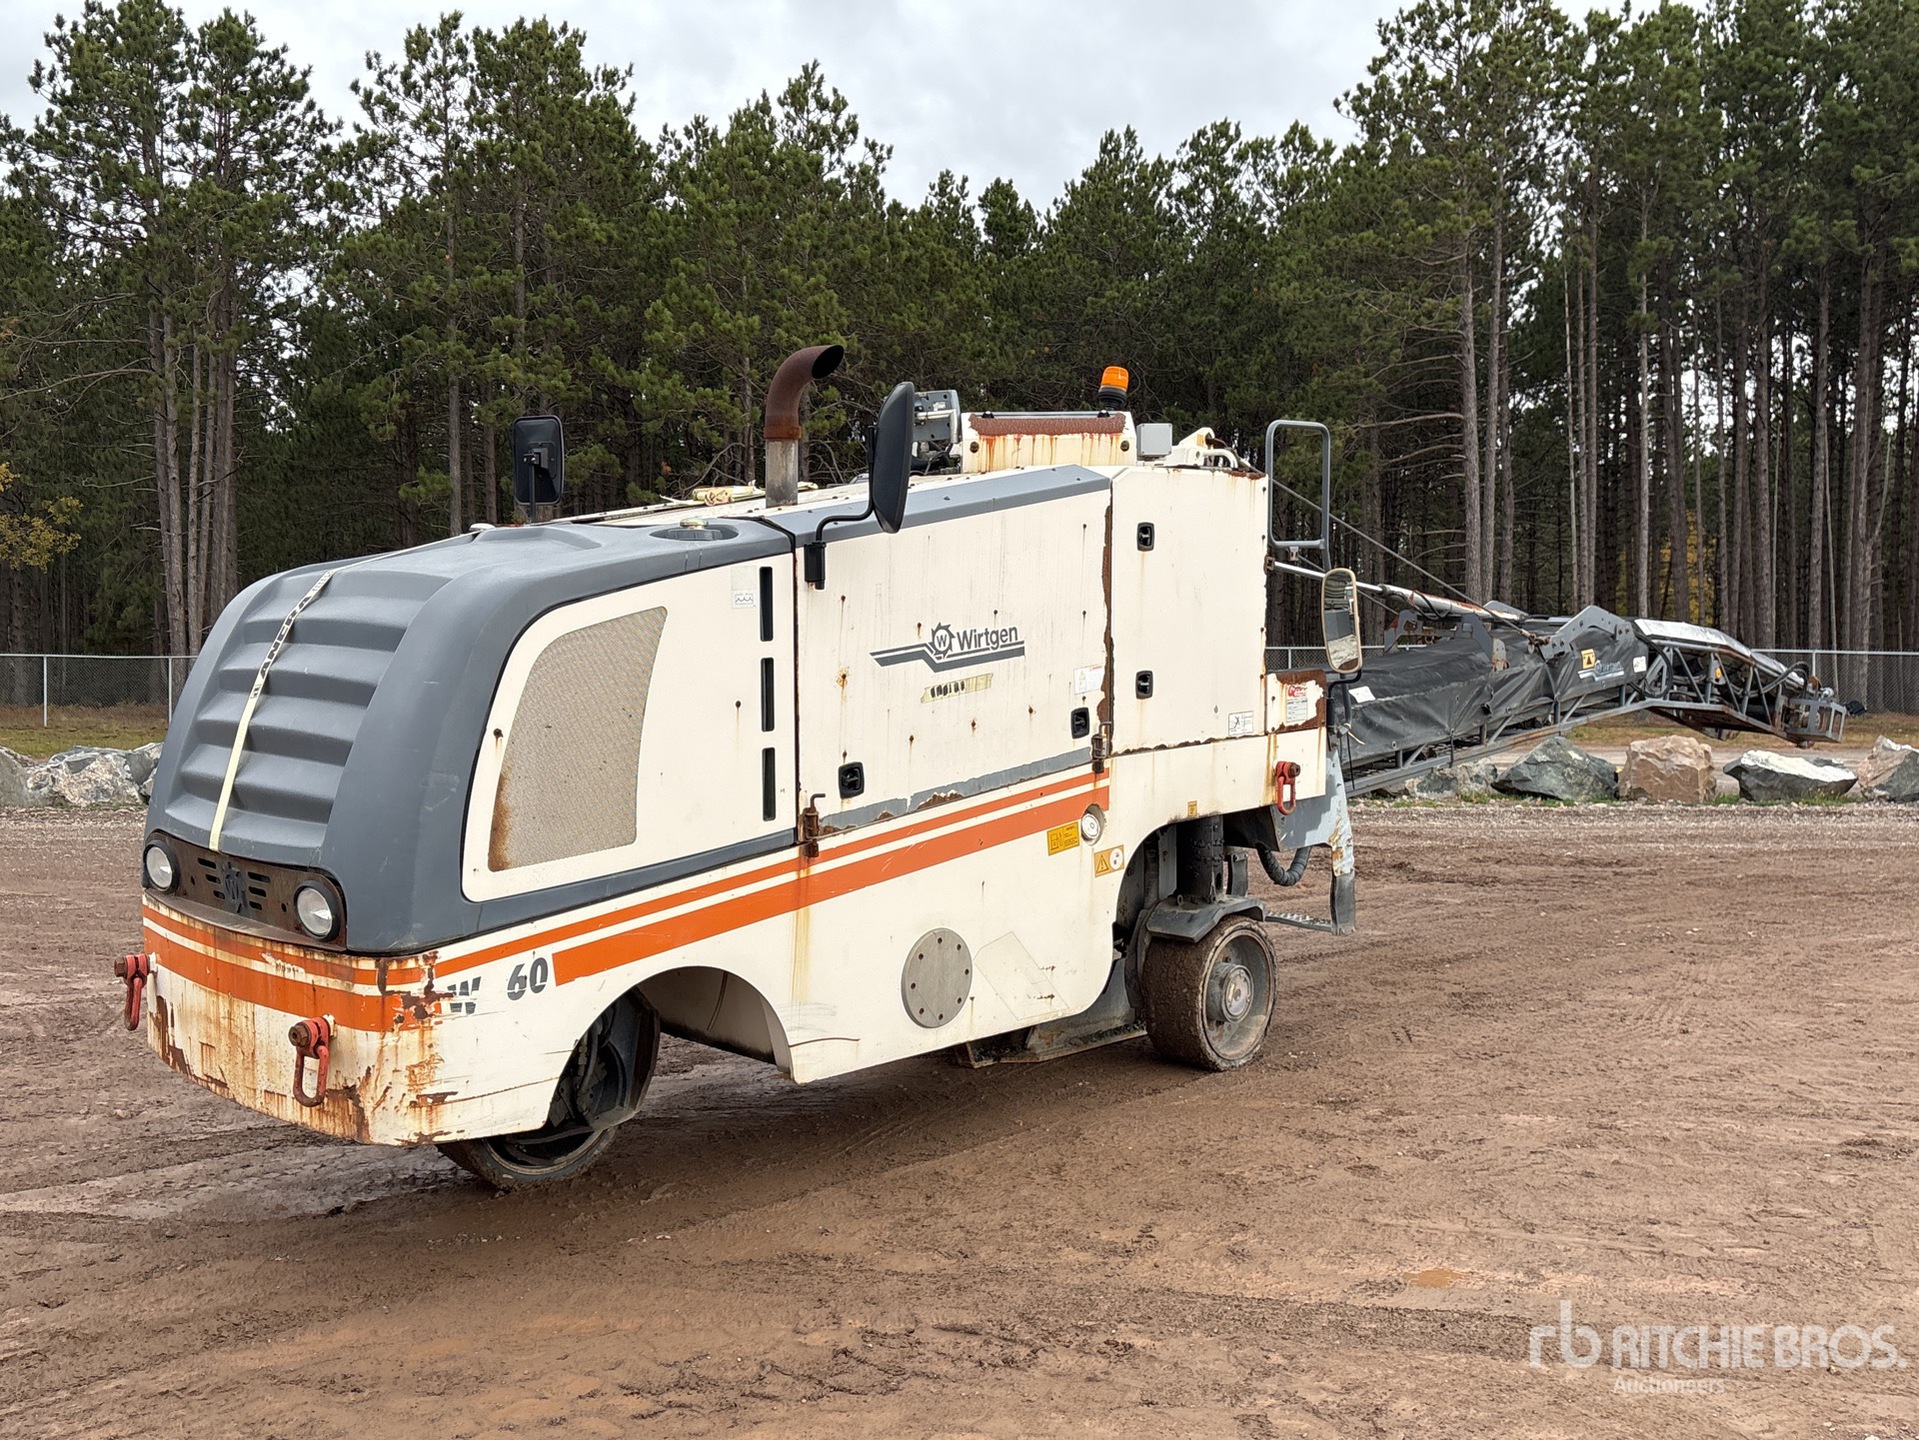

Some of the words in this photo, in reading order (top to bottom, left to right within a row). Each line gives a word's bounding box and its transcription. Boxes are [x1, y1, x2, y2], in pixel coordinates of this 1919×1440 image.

[260, 595, 313, 679] ANCRA
[936, 634, 946, 648] W
[956, 626, 1018, 650] Wirtgen
[507, 957, 548, 1001] 60
